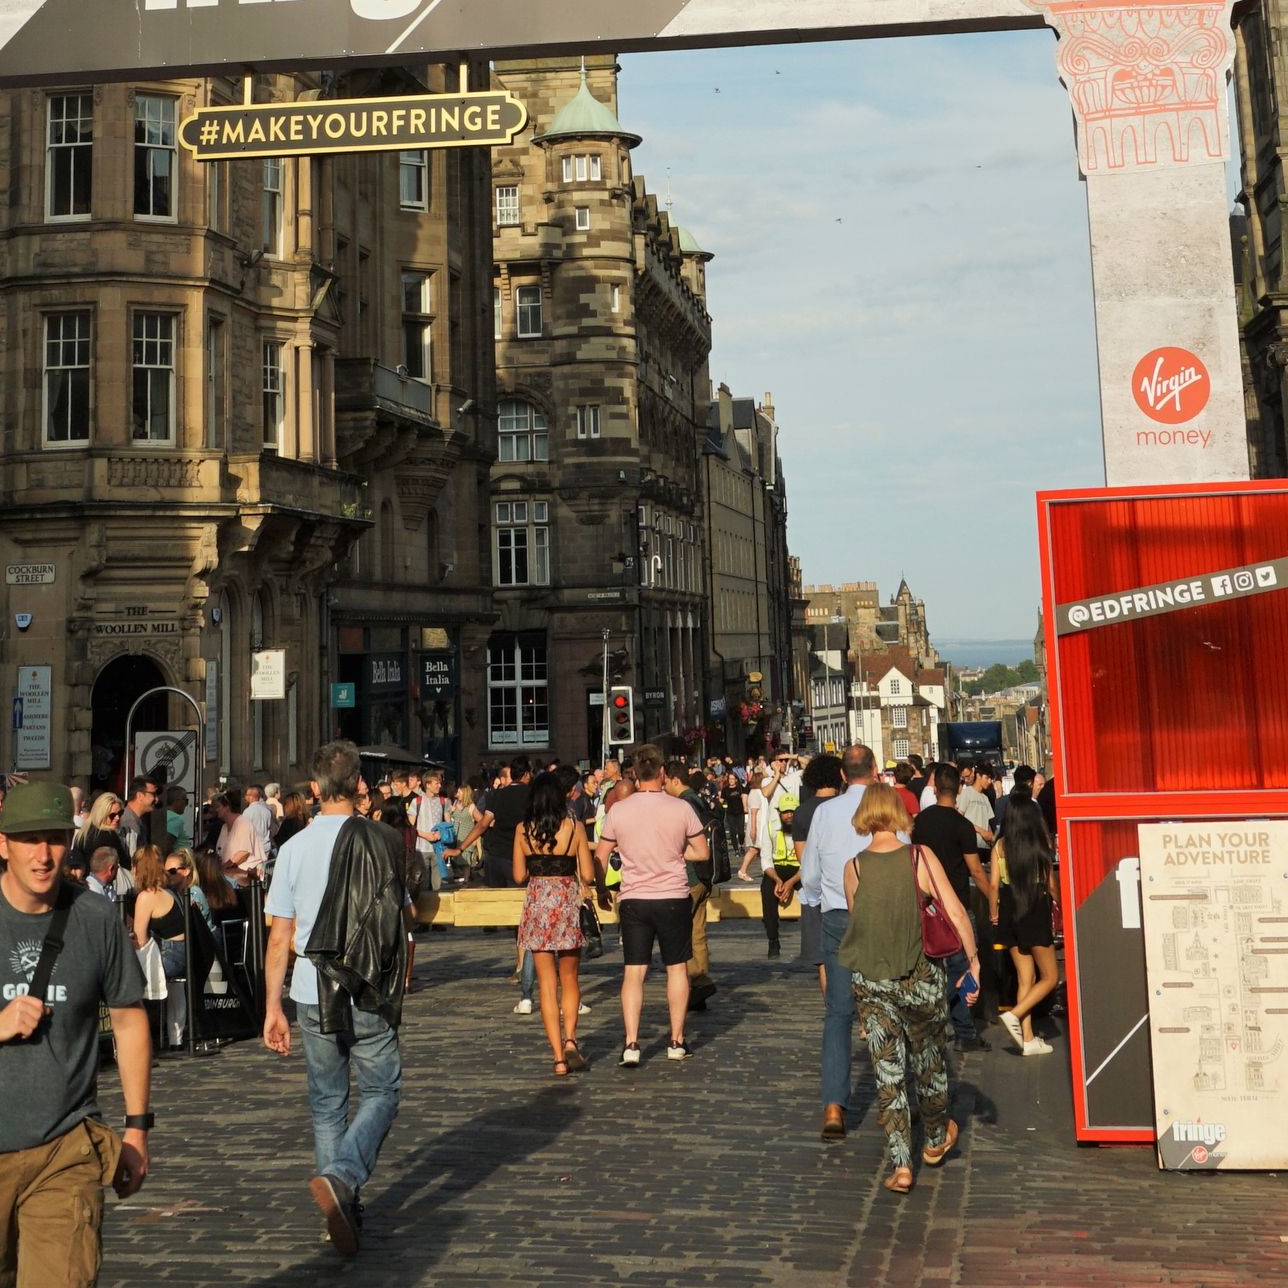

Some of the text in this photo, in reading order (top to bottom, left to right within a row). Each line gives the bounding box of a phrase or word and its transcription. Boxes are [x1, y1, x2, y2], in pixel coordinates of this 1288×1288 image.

[199, 104, 502, 146] #MAKEYOURFRINGE
[1140, 356, 1202, 411] Virgin
[1136, 429, 1212, 449] money
[8, 564, 54, 575] COCKBURN
[15, 574, 45, 583] STREET
[125, 606, 148, 616] THE
[1067, 580, 1206, 628] @EDFRINGE
[96, 623, 178, 634] WOOLLEN MILL
[372, 660, 401, 684] Bella Italia
[424, 661, 449, 672] Bella
[425, 674, 450, 685] Italia
[1162, 832, 1270, 849] PLAN YOUR
[1163, 850, 1272, 866] ADVENTURE
[1172, 1120, 1226, 1145] fringe
